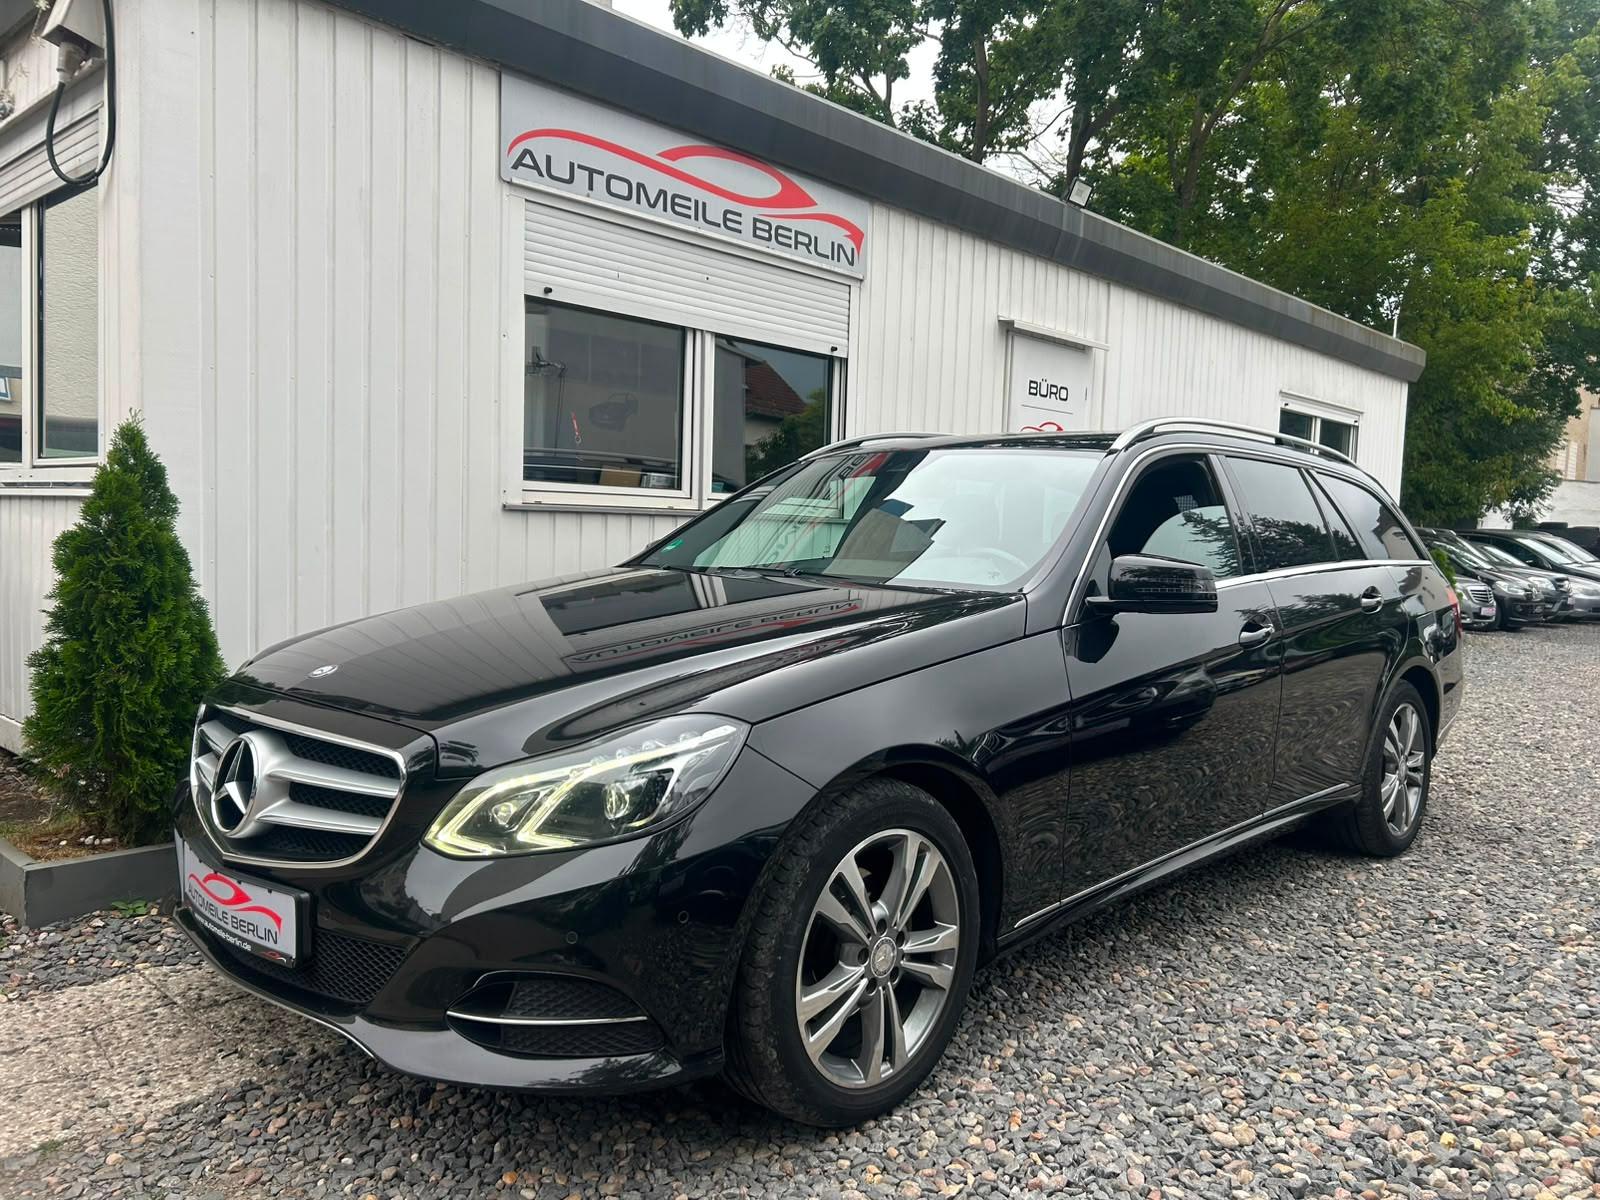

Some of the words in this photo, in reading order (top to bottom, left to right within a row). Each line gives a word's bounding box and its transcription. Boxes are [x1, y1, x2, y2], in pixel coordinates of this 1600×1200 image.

[510, 147, 743, 235] AUTOMEILE
[752, 216, 856, 267] BERLIN
[1028, 378, 1069, 402] BÜRO
[188, 882, 230, 926] AUTOMEILE
[231, 915, 278, 945] BERLIN
